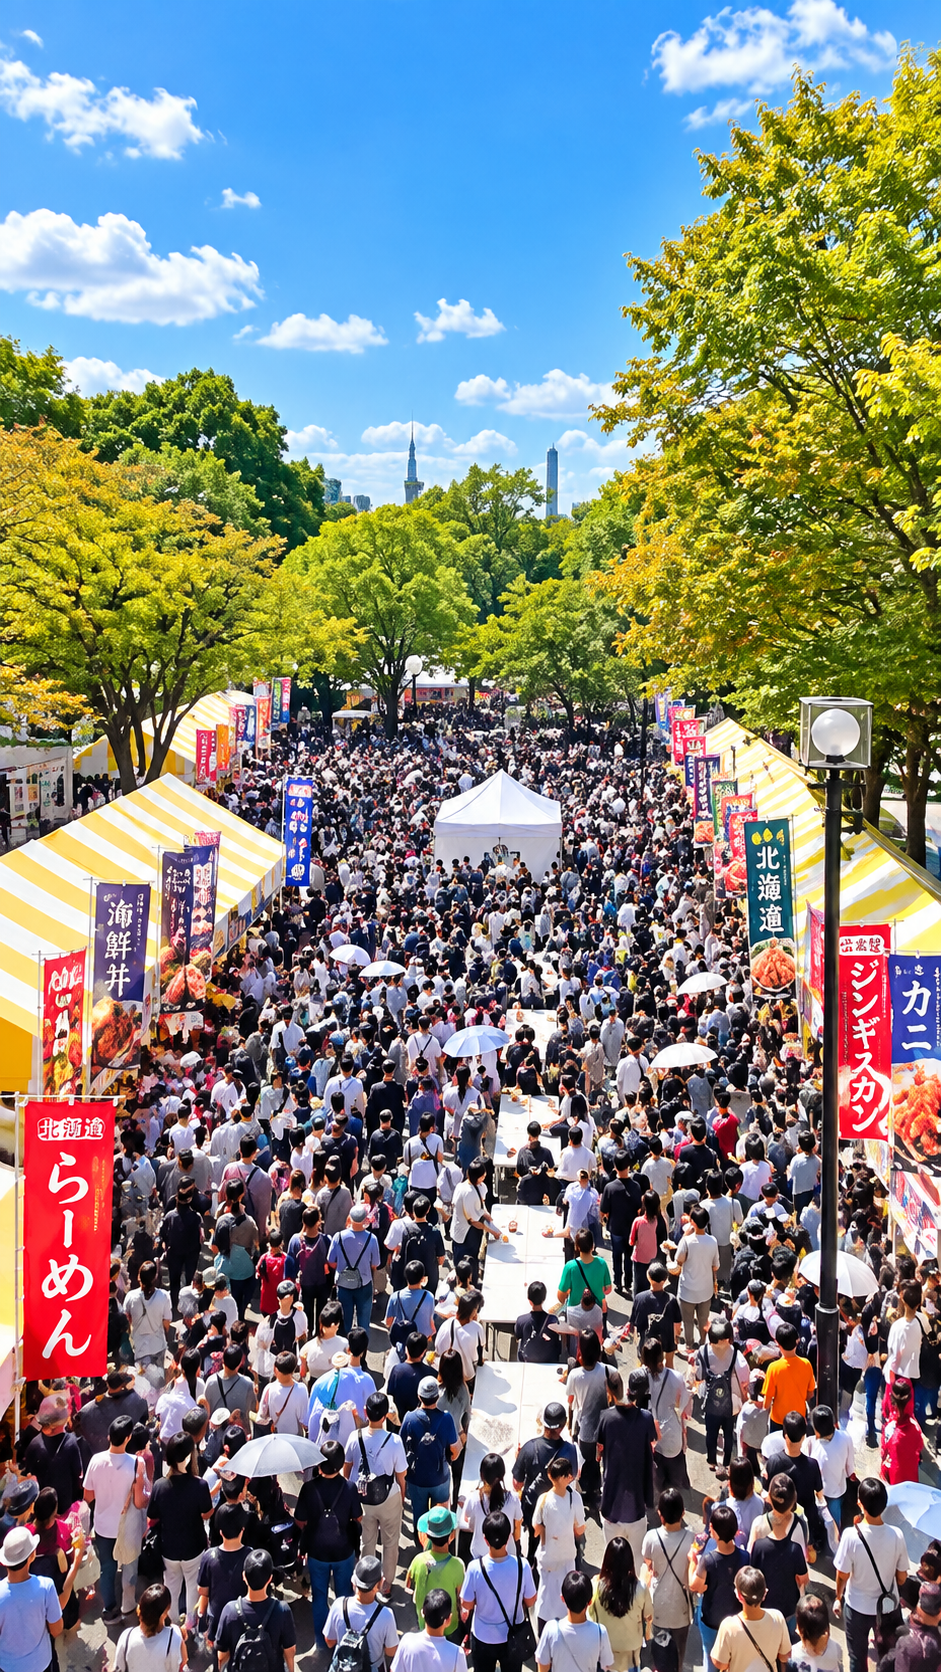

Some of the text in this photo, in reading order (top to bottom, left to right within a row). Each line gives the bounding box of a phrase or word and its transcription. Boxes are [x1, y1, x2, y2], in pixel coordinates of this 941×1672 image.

[850, 959, 880, 1133] ジンギスカン
[901, 980, 932, 1051] カニ
[41, 1151, 94, 1360] らーめん
